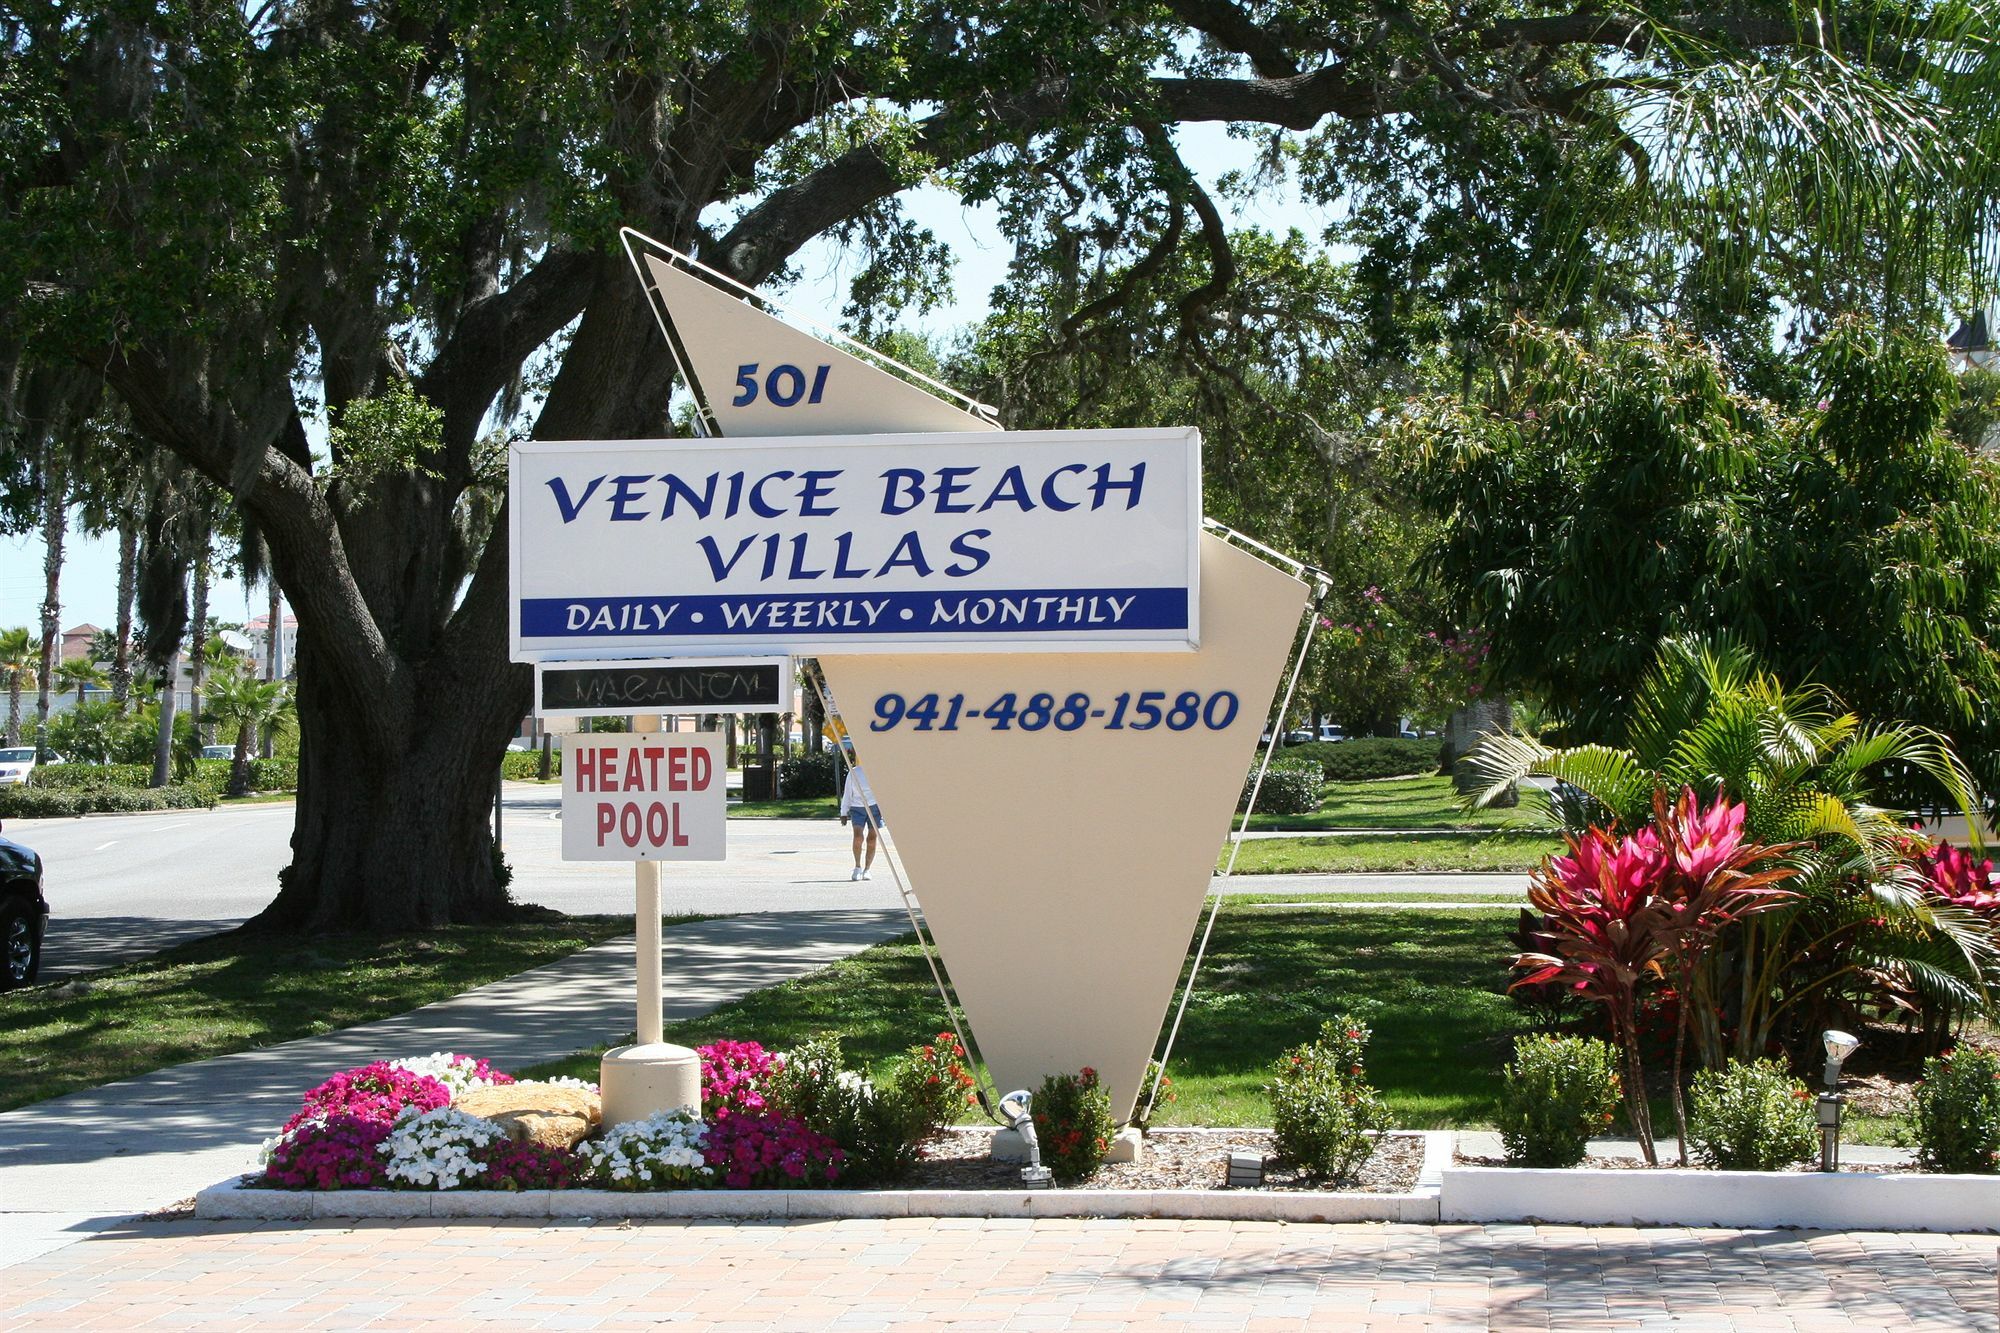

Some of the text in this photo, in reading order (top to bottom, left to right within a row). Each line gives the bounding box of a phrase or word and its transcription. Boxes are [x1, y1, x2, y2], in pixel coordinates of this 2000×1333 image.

[731, 362, 831, 407] 501
[545, 462, 1147, 524] VENICE BEACH
[696, 528, 992, 582] VILLAS
[566, 595, 1136, 631] DAILY WEEKLY MONTHLY
[869, 691, 1239, 732] 941-488-1580
[576, 747, 712, 793] HEATED
[597, 801, 689, 848] POOL
